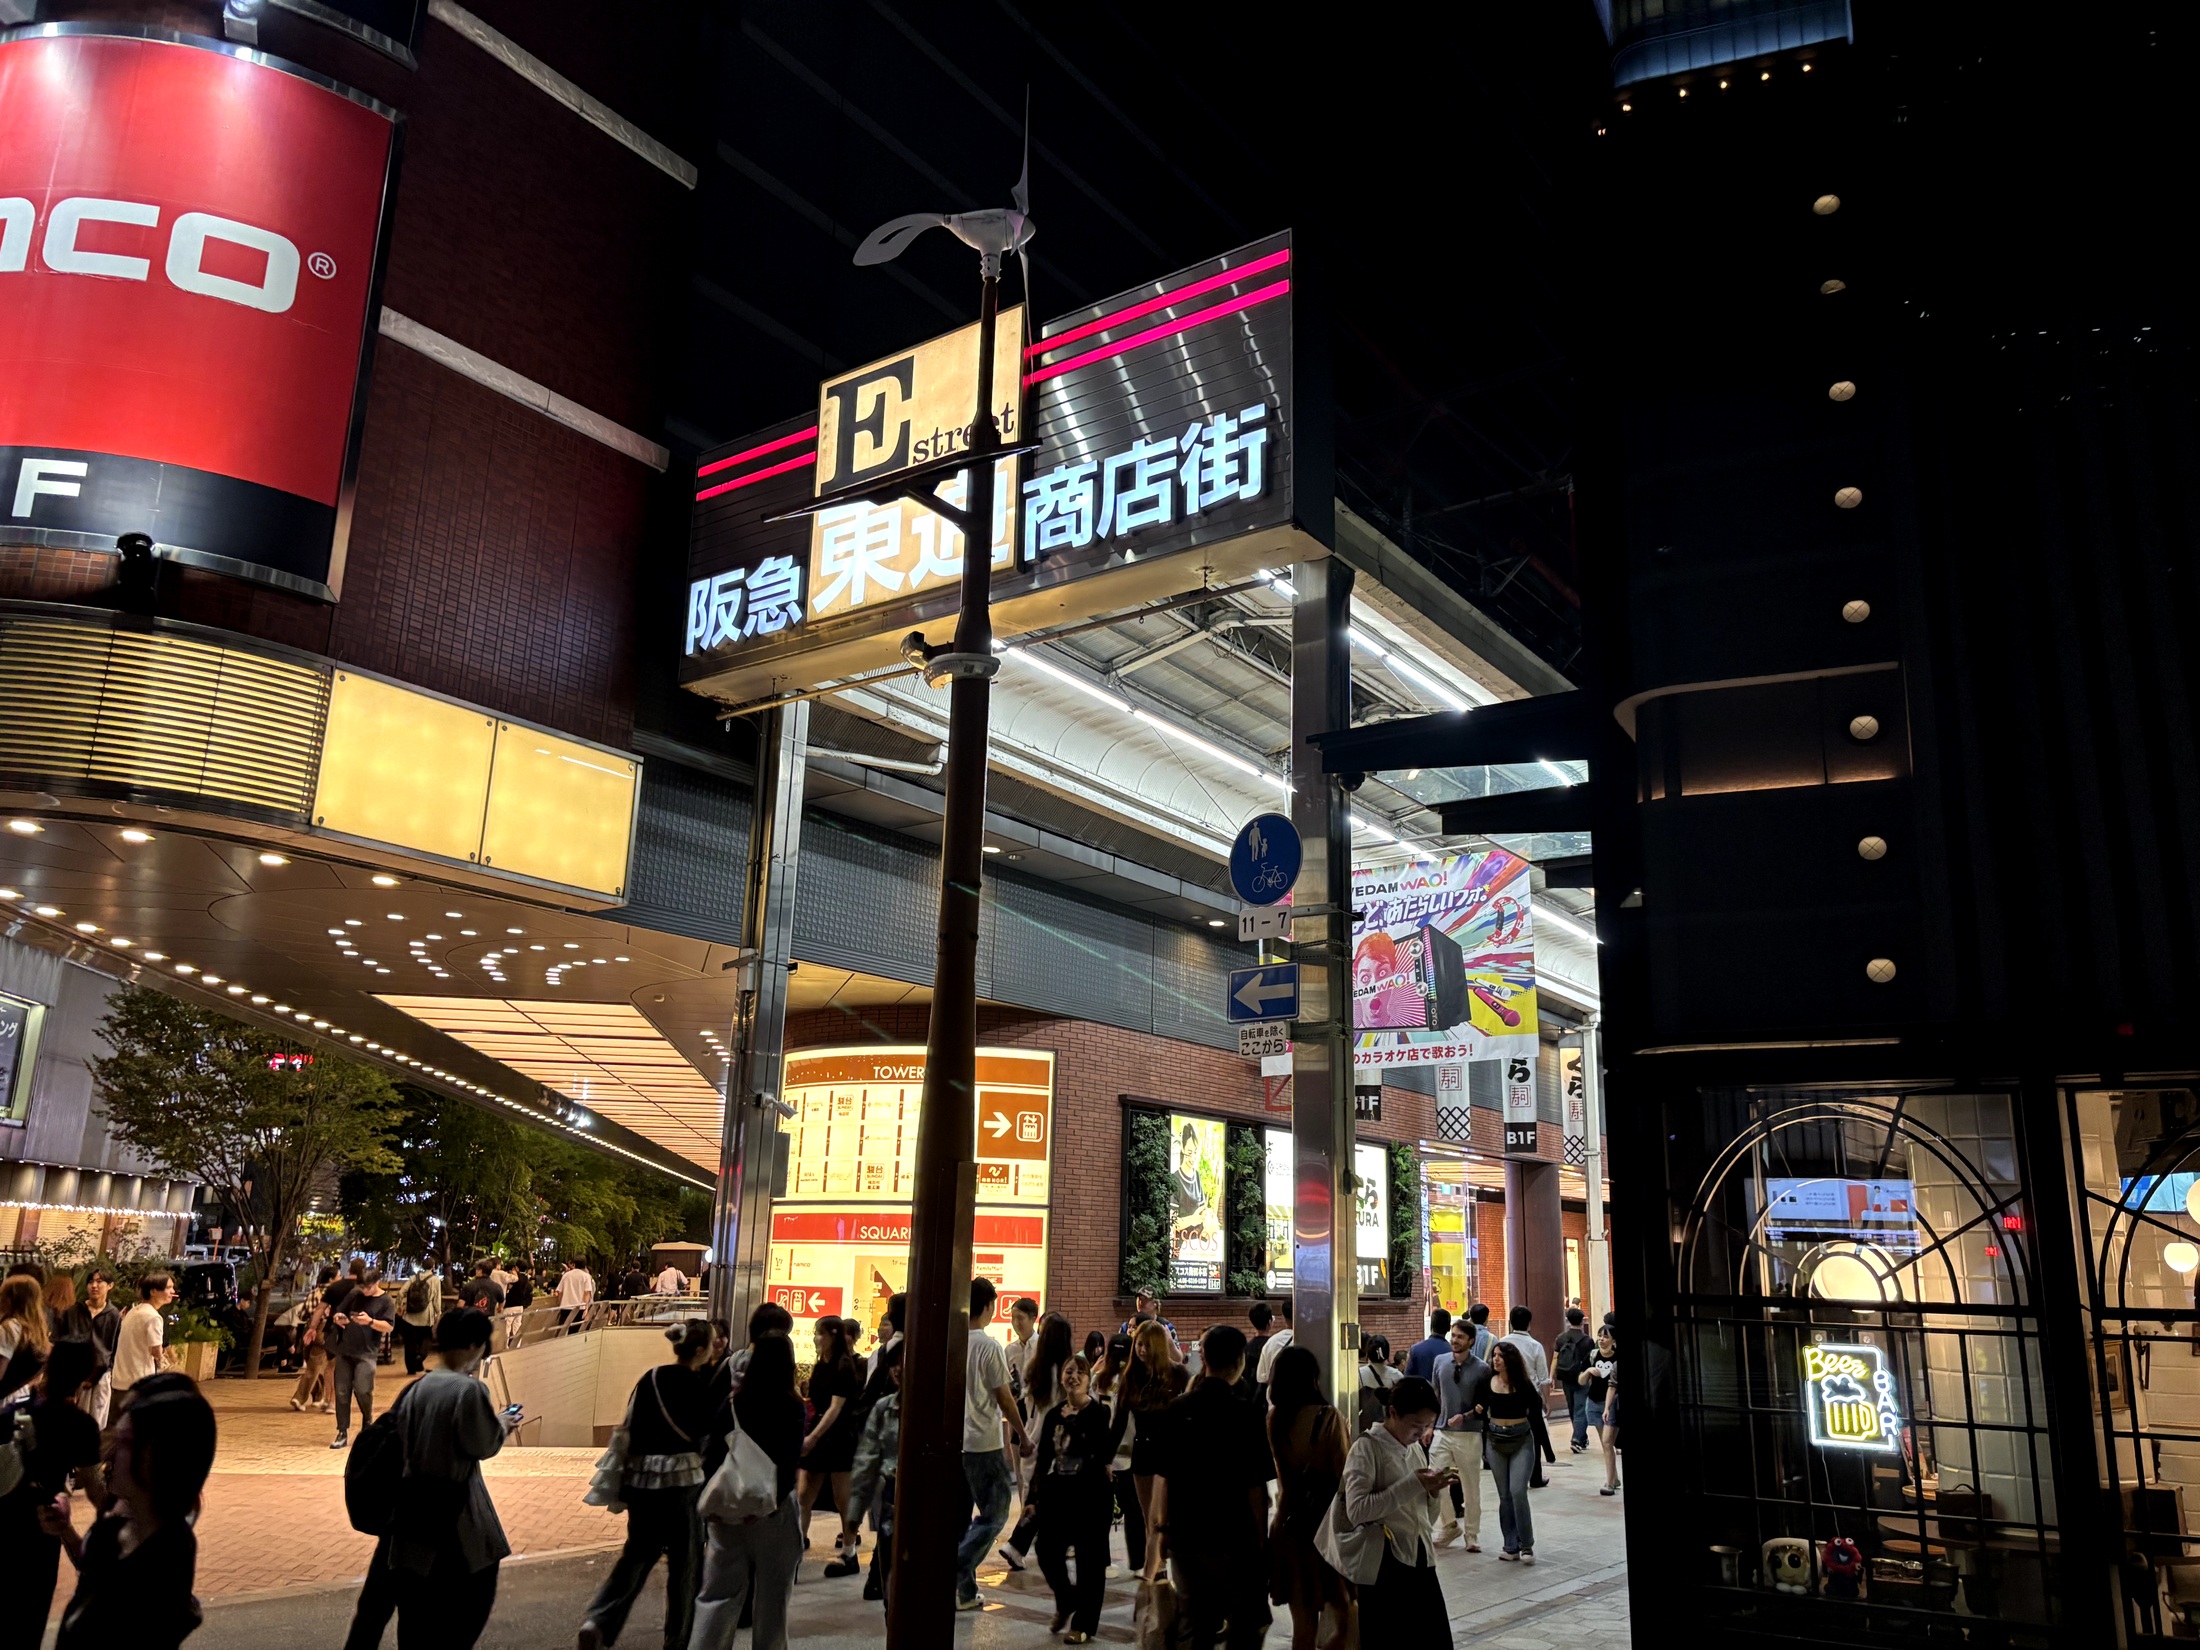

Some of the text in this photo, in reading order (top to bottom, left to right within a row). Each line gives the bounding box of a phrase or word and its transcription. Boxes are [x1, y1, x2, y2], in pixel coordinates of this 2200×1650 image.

[686, 554, 803, 656] 阪急
[1023, 402, 1267, 562] 商店街
[1240, 1025, 1284, 1041] 自転車を除く
[1241, 1038, 1284, 1056] ここから
[873, 1065, 926, 1079] TOWER
[1506, 1131, 1536, 1145] B1F
[1803, 1346, 1869, 1381] Beer
[1873, 1369, 1899, 1437] BAR
